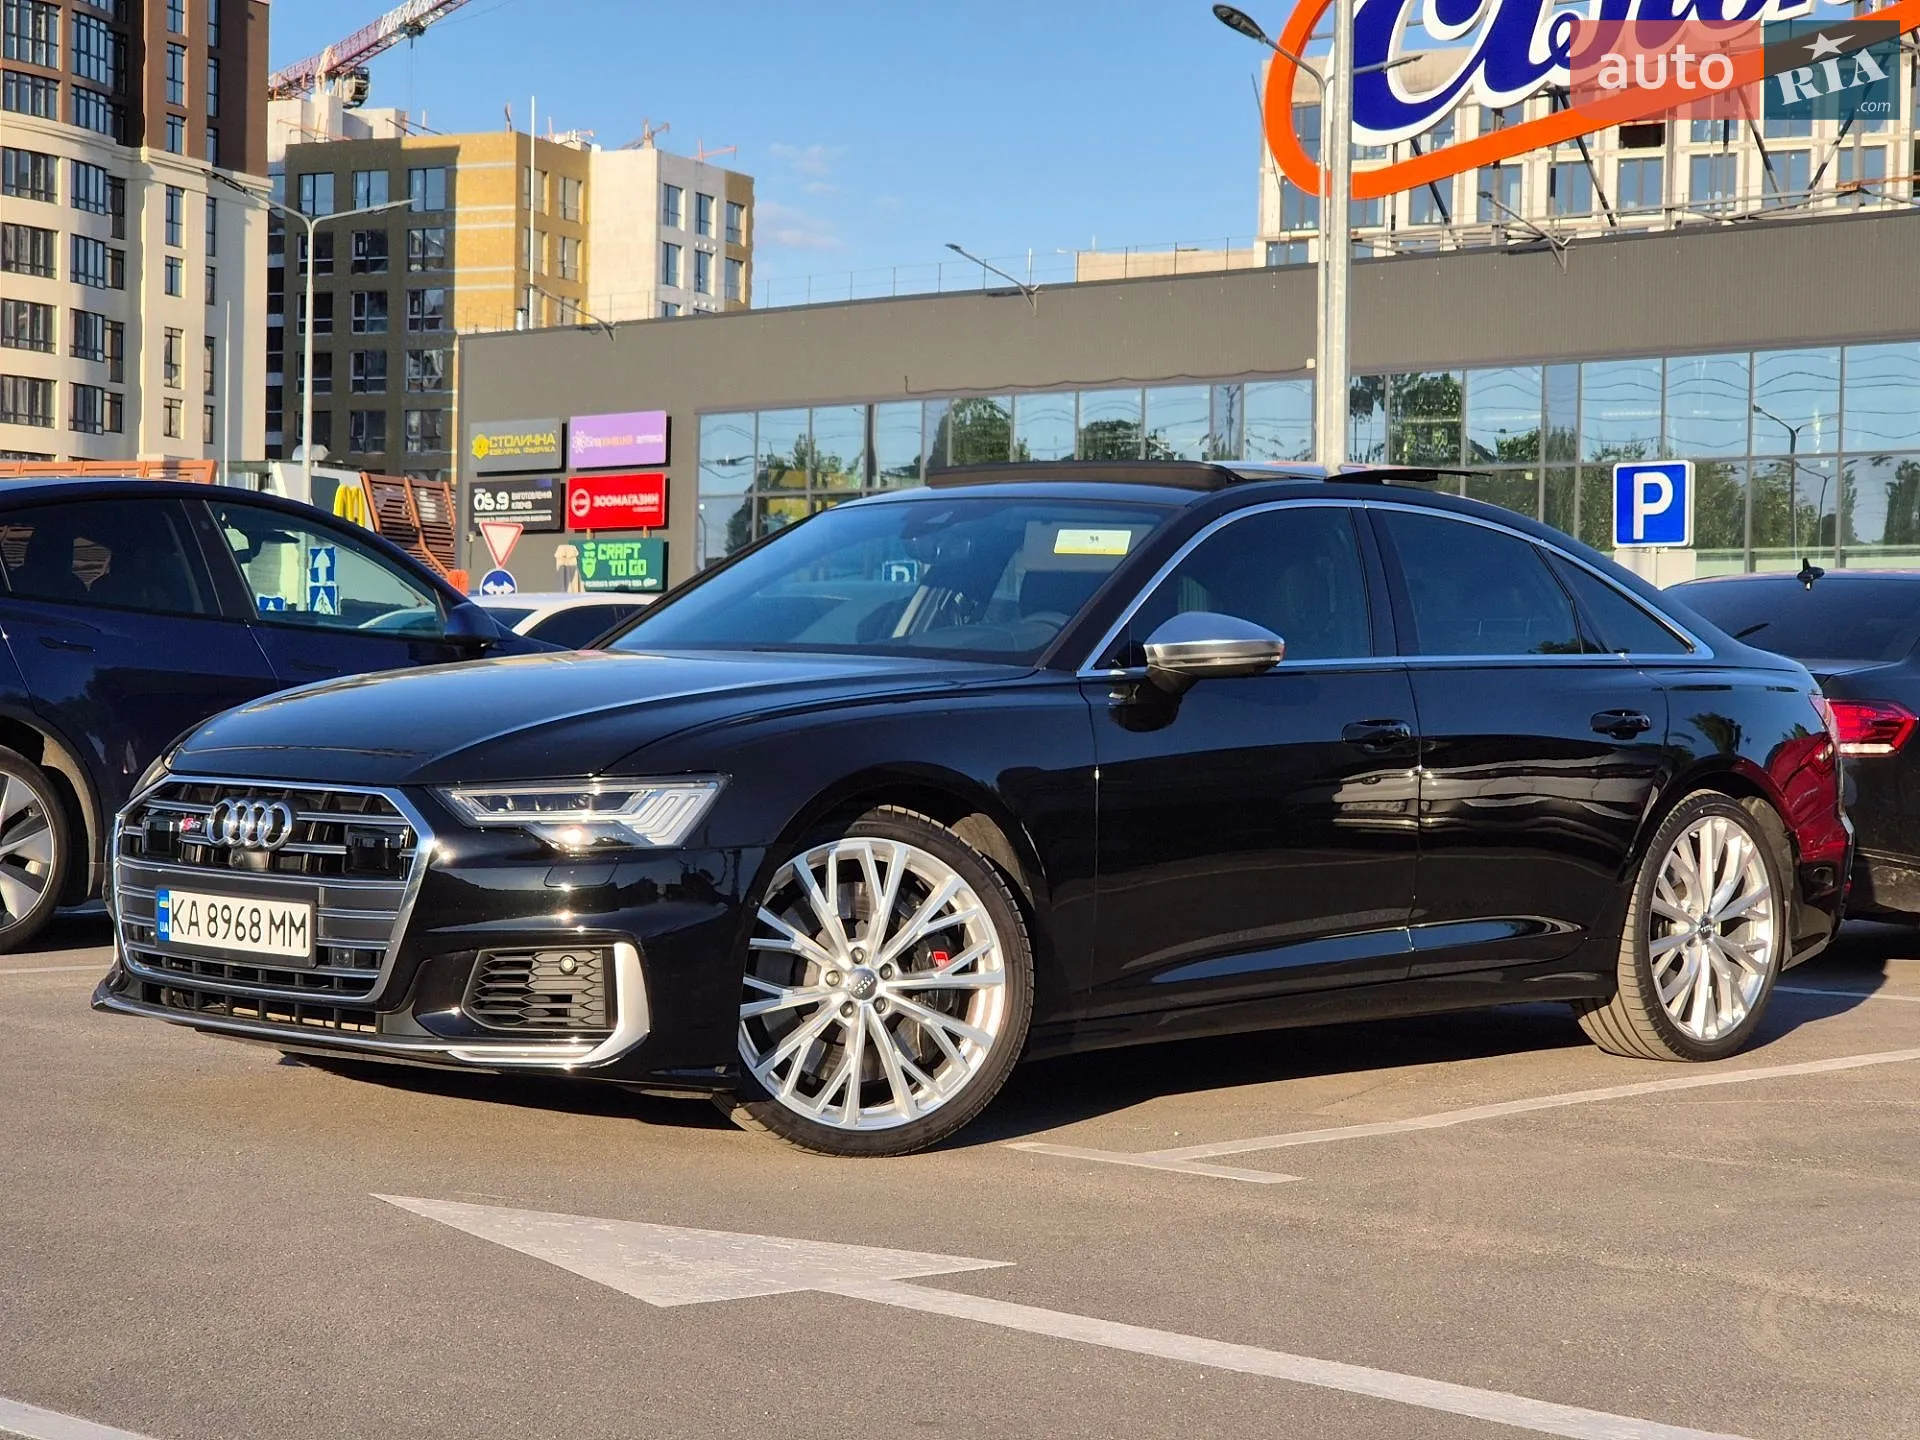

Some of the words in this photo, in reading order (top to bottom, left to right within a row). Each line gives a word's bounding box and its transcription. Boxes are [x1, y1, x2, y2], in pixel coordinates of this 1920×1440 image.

[488, 433, 557, 449] СТОЛИЧНА
[592, 493, 660, 508] ЗООМАГАЗИН
[1633, 471, 1674, 540] P
[597, 543, 642, 561] CRAFT
[608, 559, 627, 576] TO
[628, 559, 647, 576] GO
[160, 921, 169, 933] UA
[171, 898, 201, 937] KA
[207, 903, 262, 943] 8968
[268, 909, 307, 948] MM
